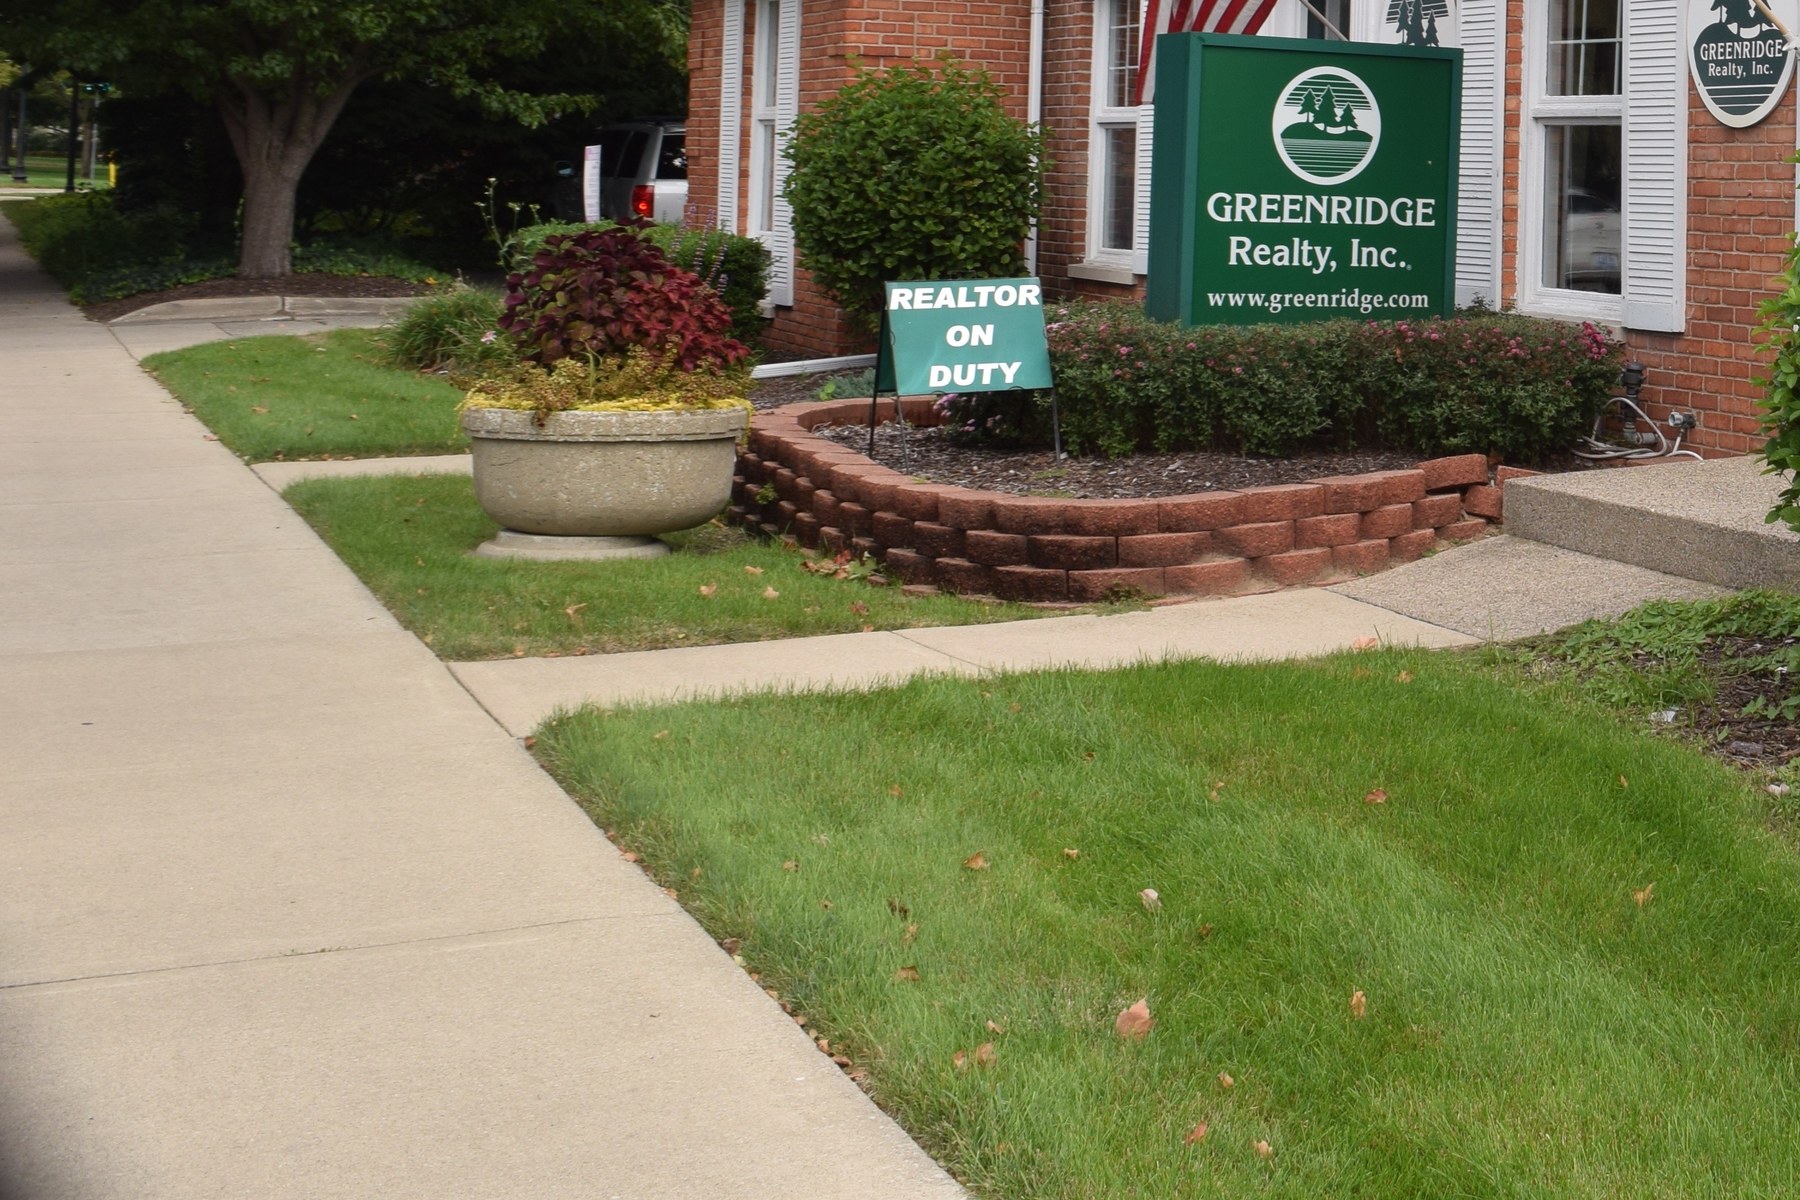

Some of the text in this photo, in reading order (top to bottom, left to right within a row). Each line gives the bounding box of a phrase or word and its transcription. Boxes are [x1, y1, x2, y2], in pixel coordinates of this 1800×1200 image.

[1700, 39, 1784, 61] GREENRIDGE
[1708, 61, 1774, 79] Realty, Inc.
[1206, 191, 1436, 227] GREENRIDGE
[1227, 236, 1407, 275] Realty, Inc.
[889, 284, 1041, 311] REALTOR
[1206, 288, 1429, 314] www.greenridge.com
[946, 324, 995, 347] ON
[929, 361, 1022, 388] DUTY
